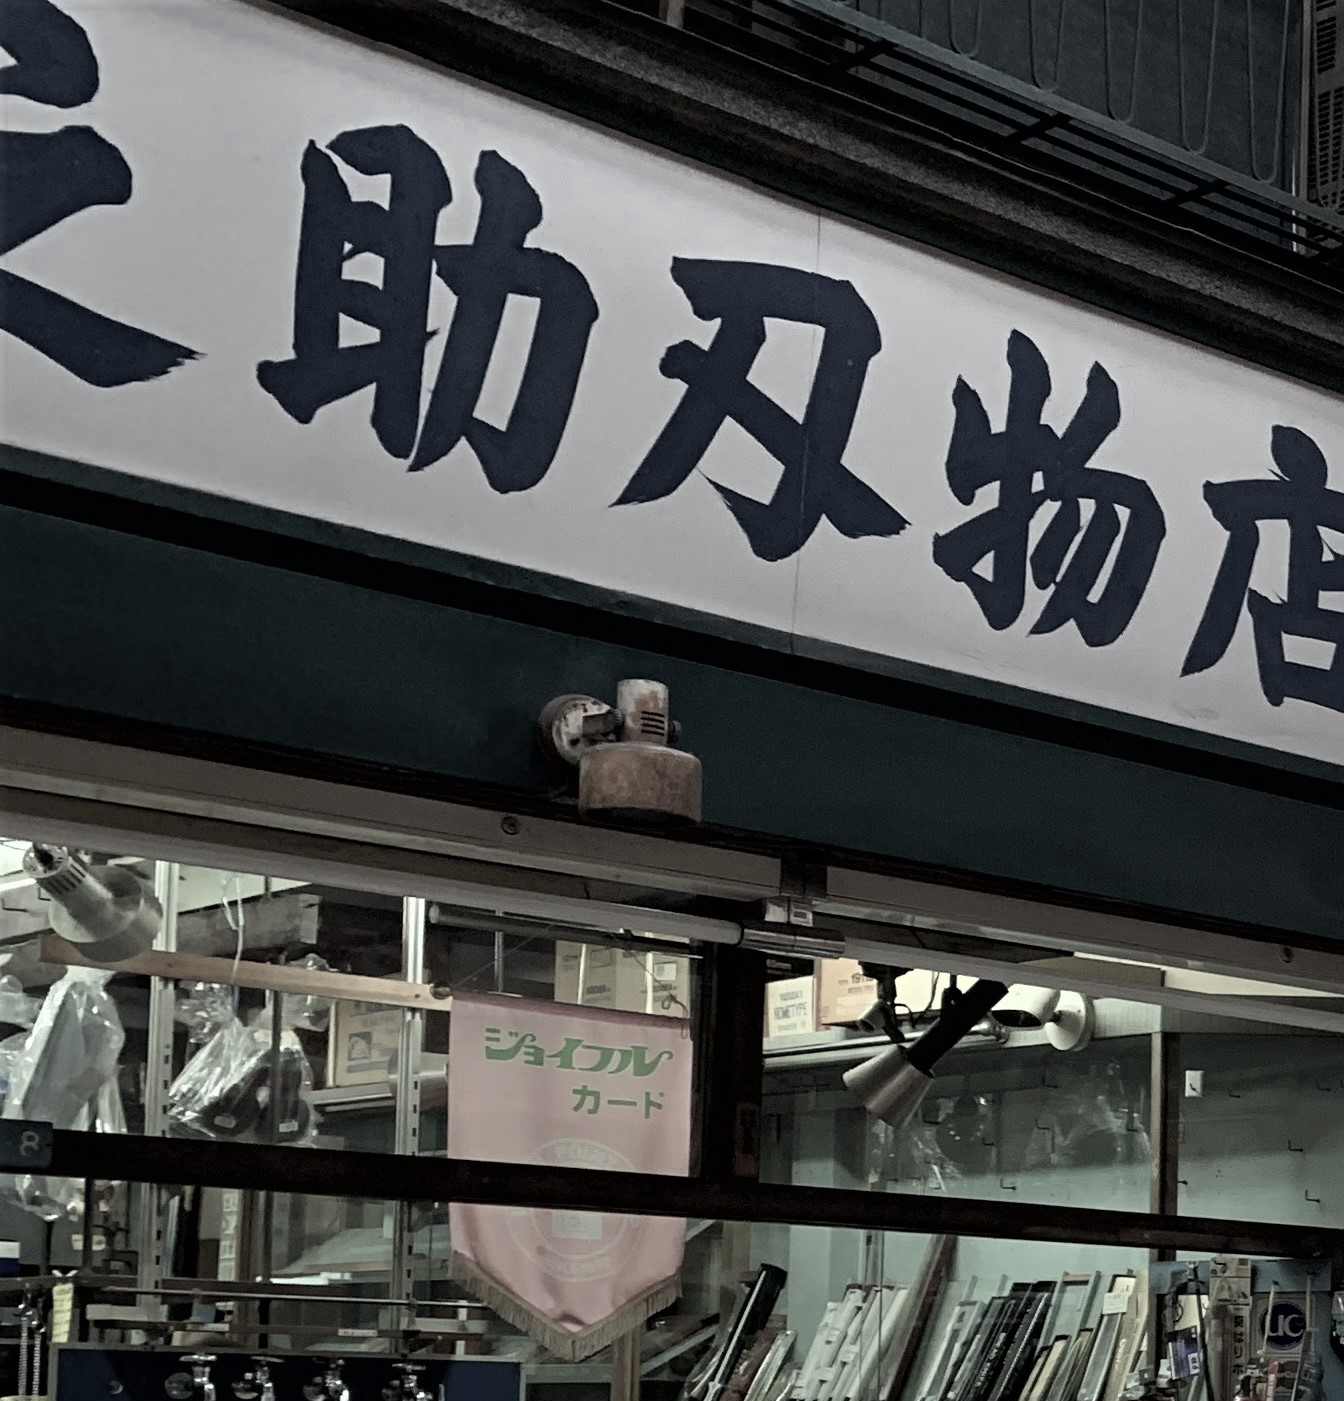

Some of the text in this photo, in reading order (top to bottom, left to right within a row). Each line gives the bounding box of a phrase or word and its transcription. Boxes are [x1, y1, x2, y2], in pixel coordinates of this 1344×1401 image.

[484, 1027, 673, 1078] ジョイフル
[572, 1084, 665, 1119] カード
